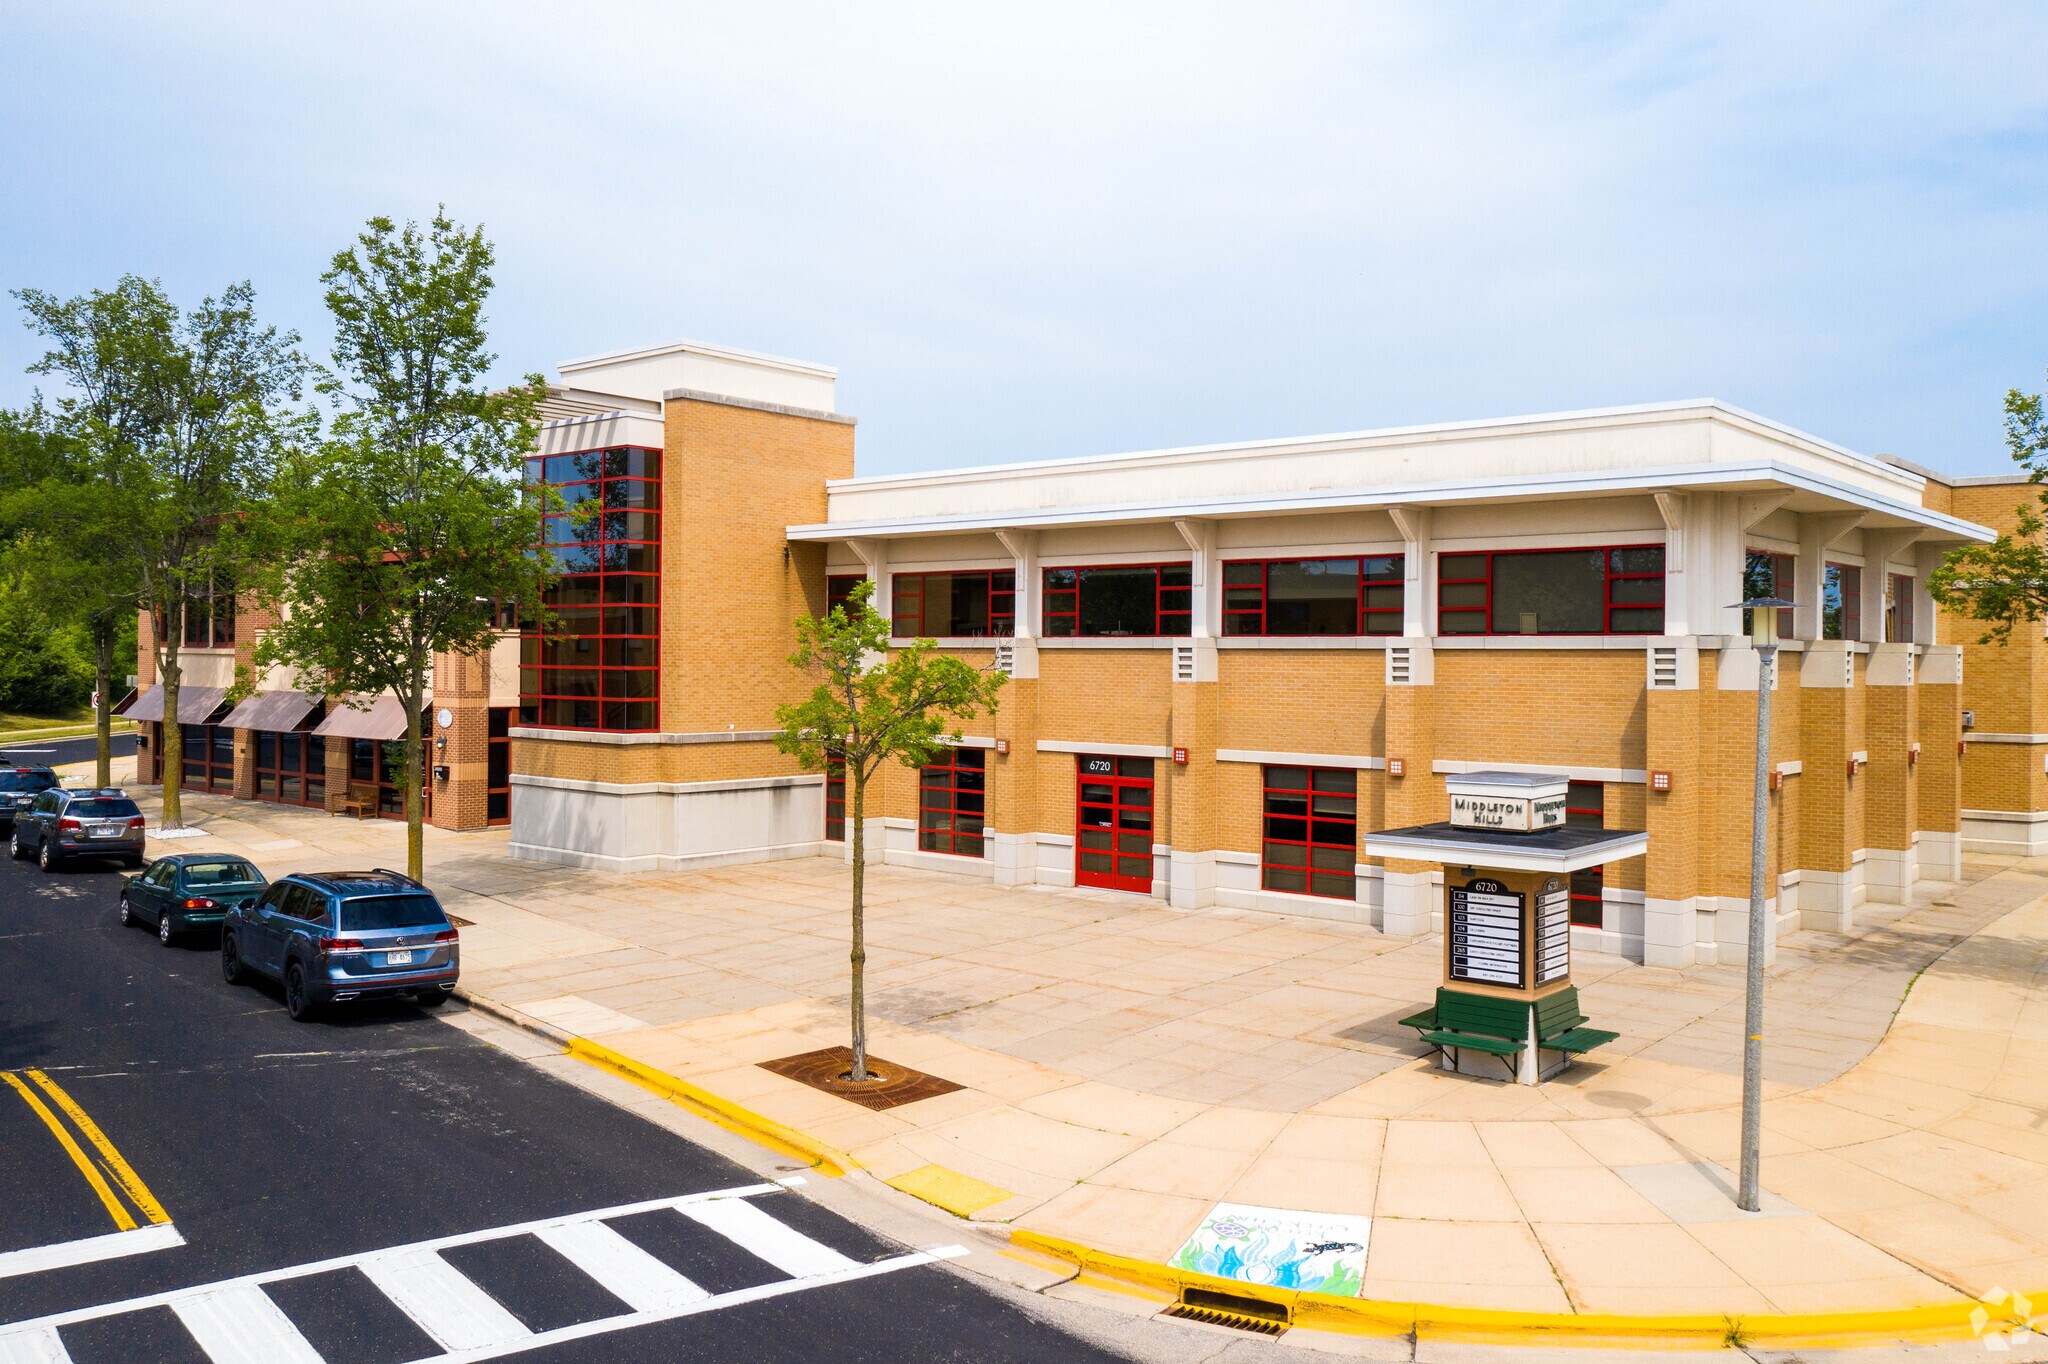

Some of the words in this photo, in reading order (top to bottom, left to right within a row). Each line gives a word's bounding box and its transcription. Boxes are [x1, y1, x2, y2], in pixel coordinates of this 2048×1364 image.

[1089, 760, 1111, 771] 6720
[1454, 799, 1523, 814] MIDDLETON
[1474, 811, 1503, 825] HILLS
[1475, 881, 1498, 893] 6720
